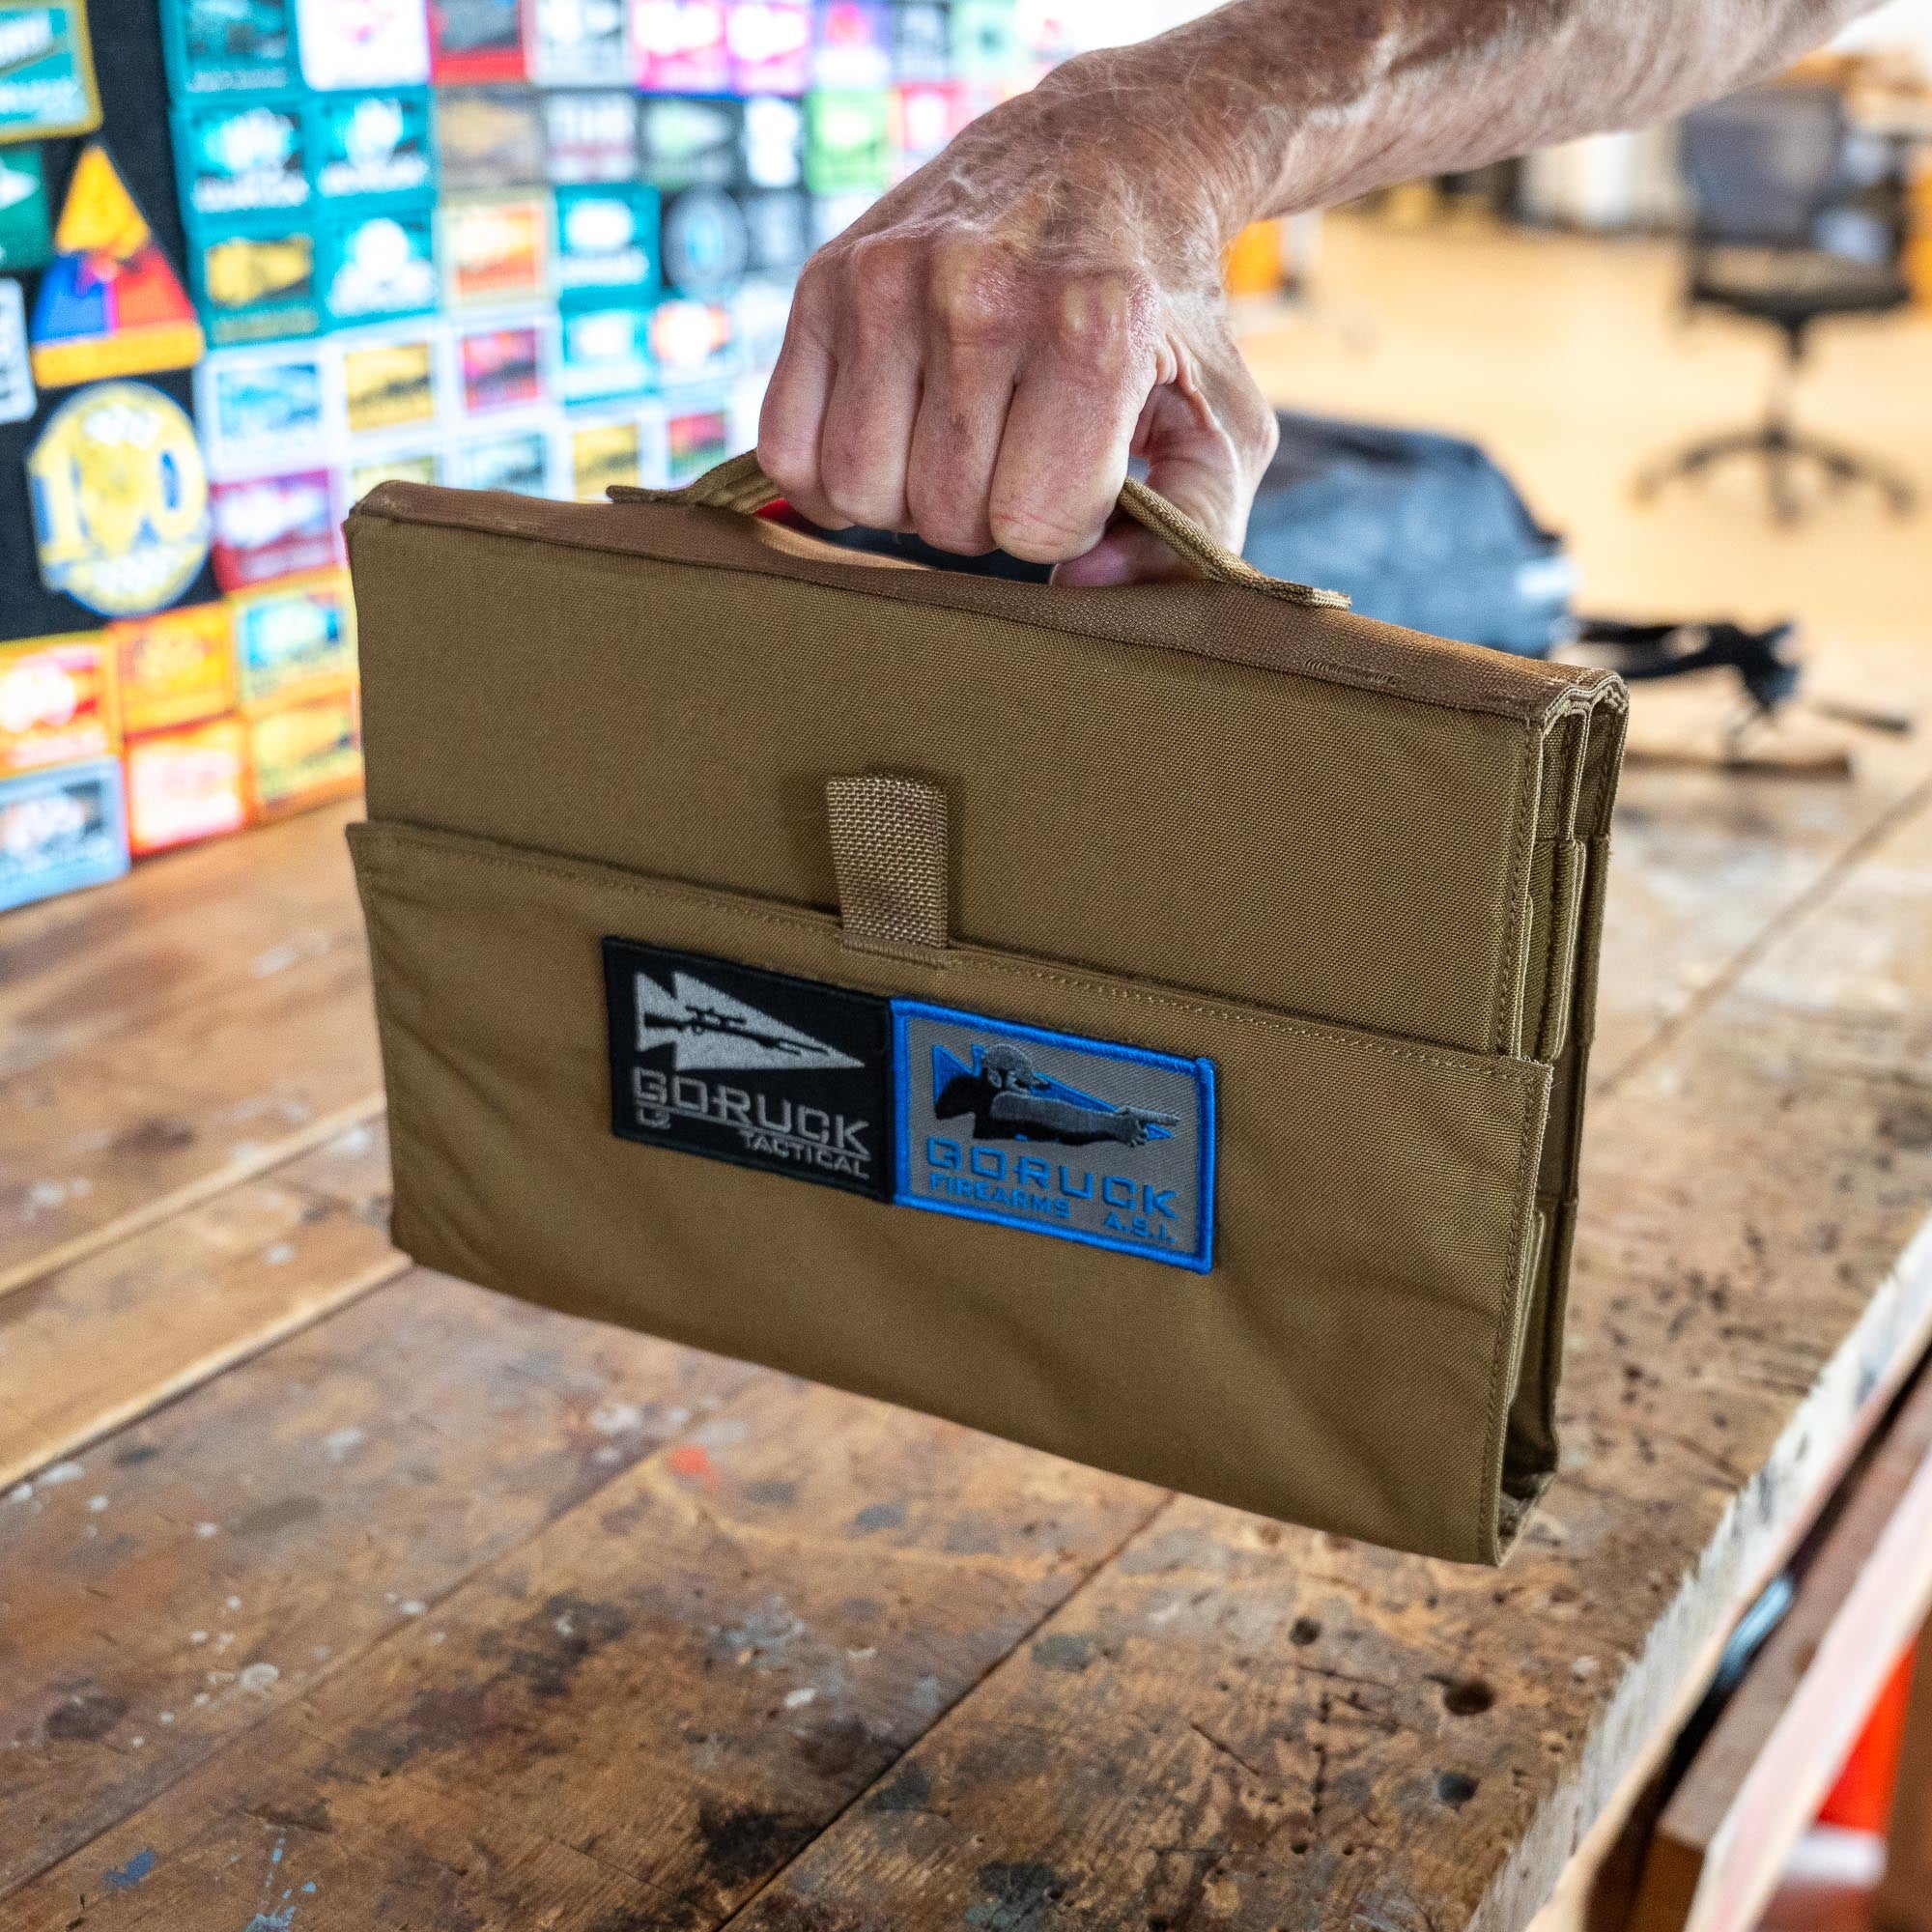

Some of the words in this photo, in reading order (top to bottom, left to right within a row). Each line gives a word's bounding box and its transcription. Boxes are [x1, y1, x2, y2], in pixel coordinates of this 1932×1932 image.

[633, 1066, 869, 1159] GORUCK
[737, 1128, 868, 1179] TACTICAL
[926, 1137, 1179, 1220] GORUCK
[929, 1173, 1071, 1218] FIREARMS
[1103, 1211, 1176, 1243] A.S.I.
